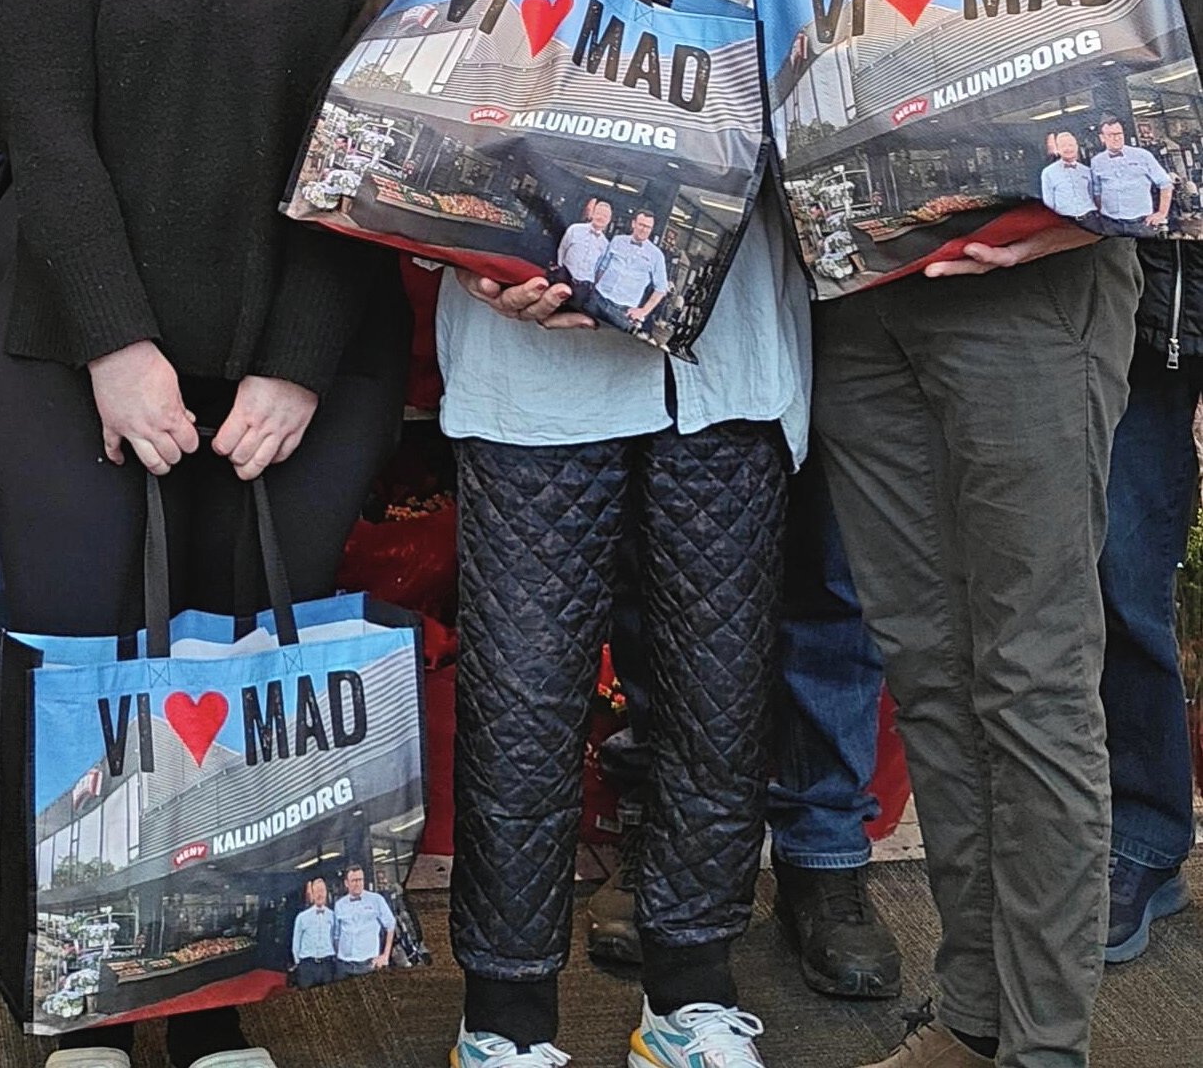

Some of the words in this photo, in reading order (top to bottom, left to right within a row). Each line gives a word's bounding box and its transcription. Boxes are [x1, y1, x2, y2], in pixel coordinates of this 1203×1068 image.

[895, 100, 926, 122] MENY
[933, 29, 1102, 109] KALUNDBORG
[471, 107, 506, 122] MENY
[510, 109, 677, 150] KALUNDBORG
[97, 692, 156, 777] VI
[241, 669, 369, 767] MAD
[175, 845, 207, 865] MENY
[212, 777, 354, 856] KALUNDBORG
